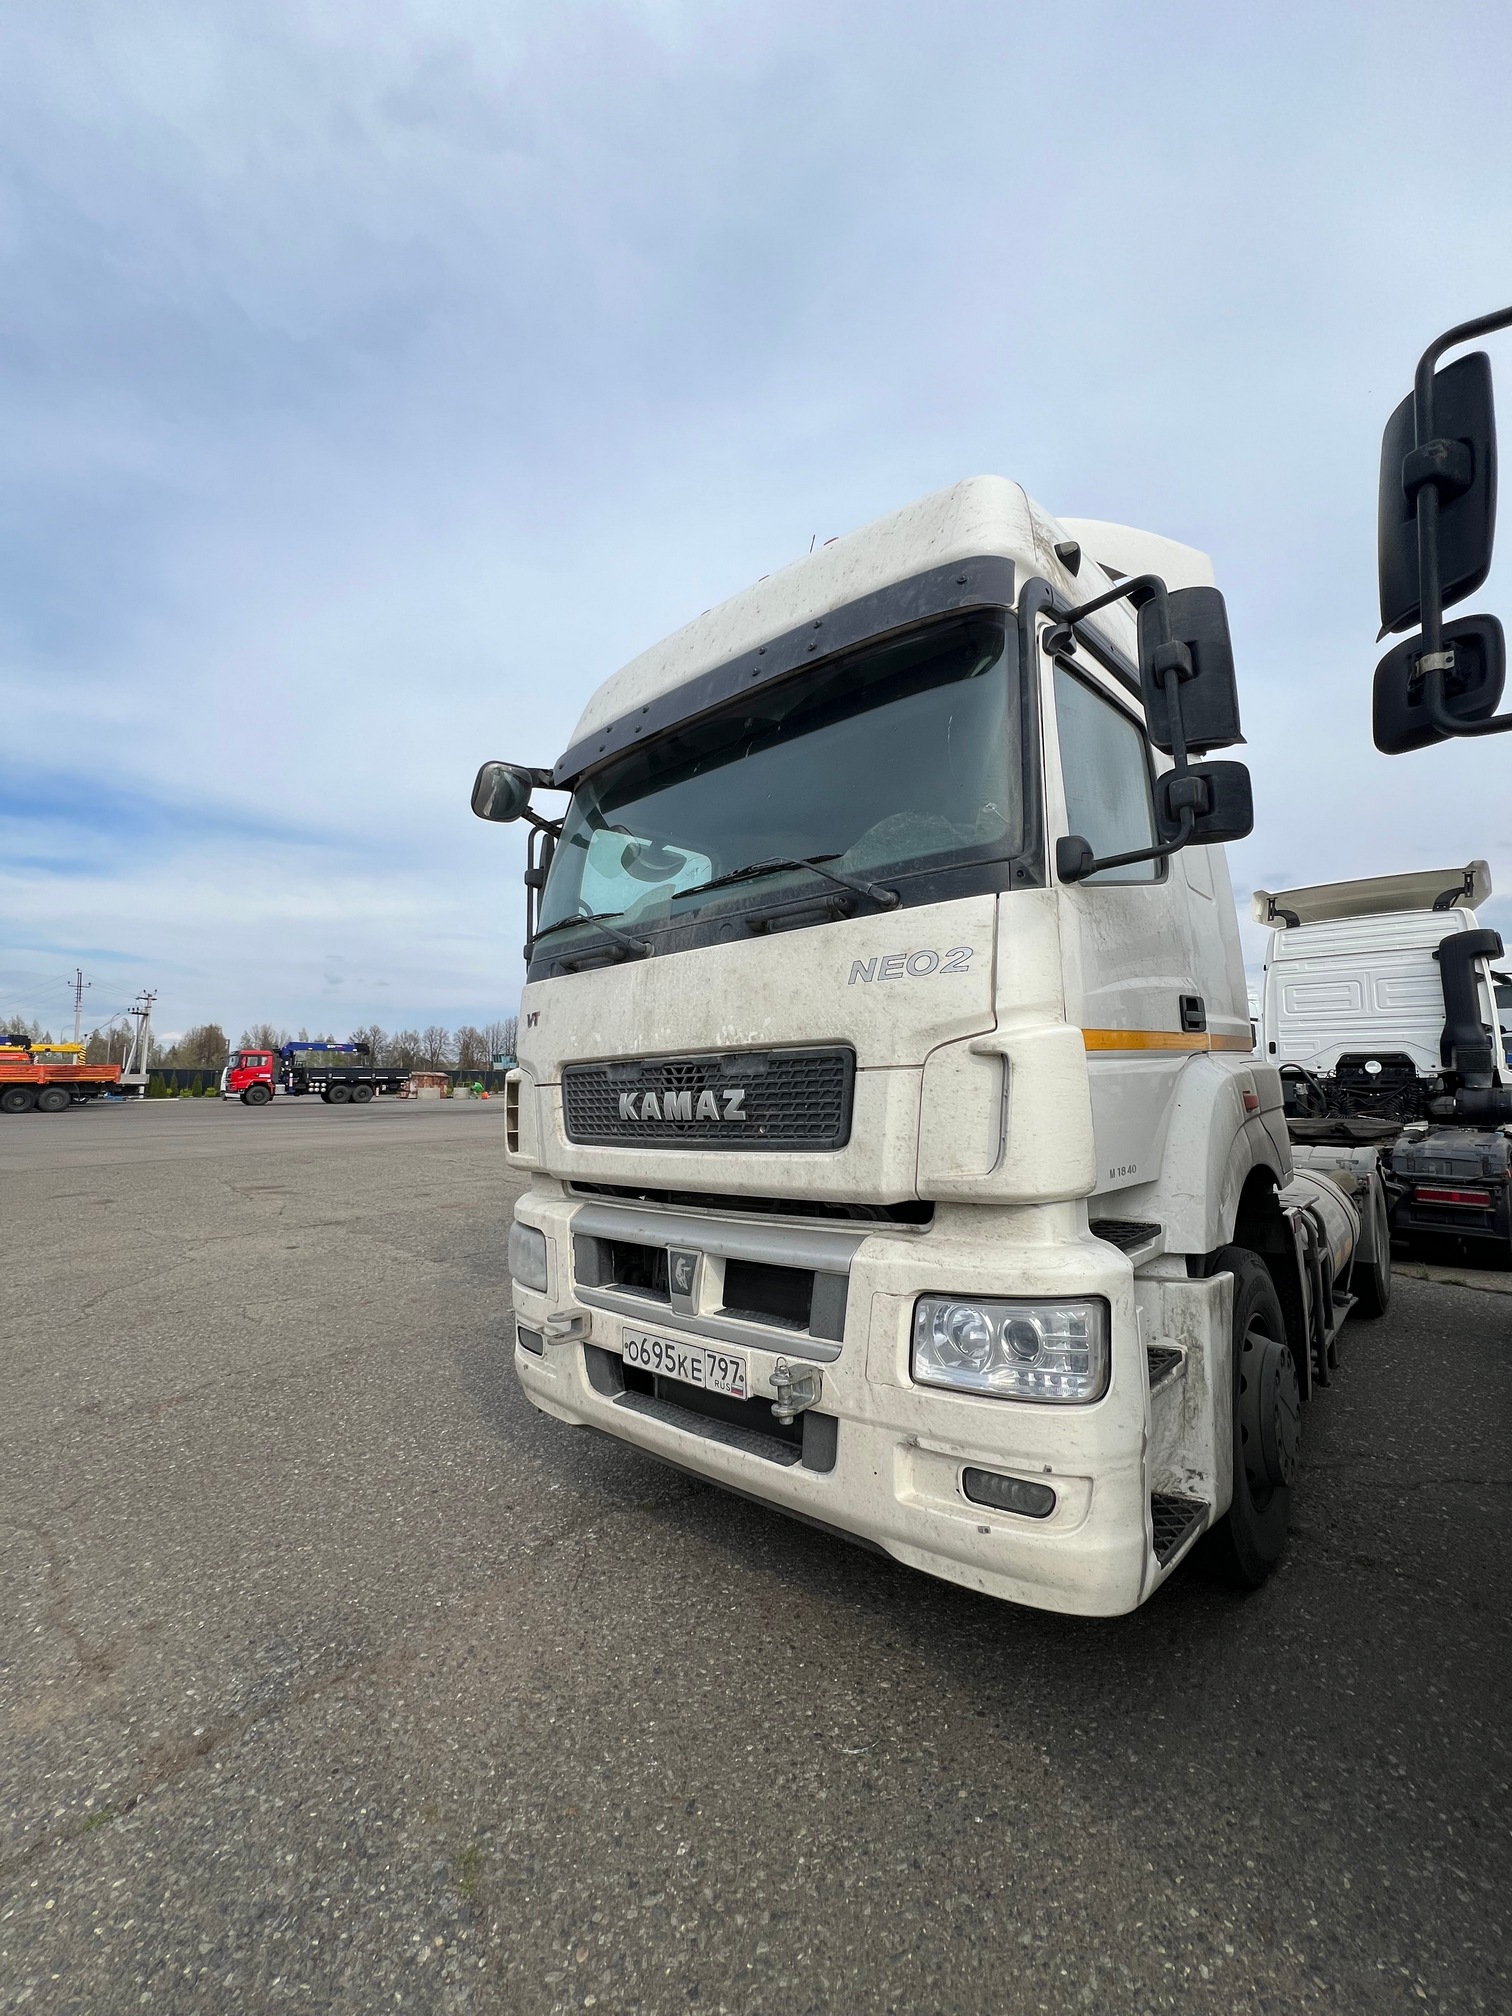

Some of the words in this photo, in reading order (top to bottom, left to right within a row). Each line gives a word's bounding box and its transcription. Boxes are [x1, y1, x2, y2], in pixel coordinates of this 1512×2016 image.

[848, 946, 973, 985] NEO2
[618, 1089, 746, 1121] KAMAZ
[714, 1379, 731, 1392] RUS
